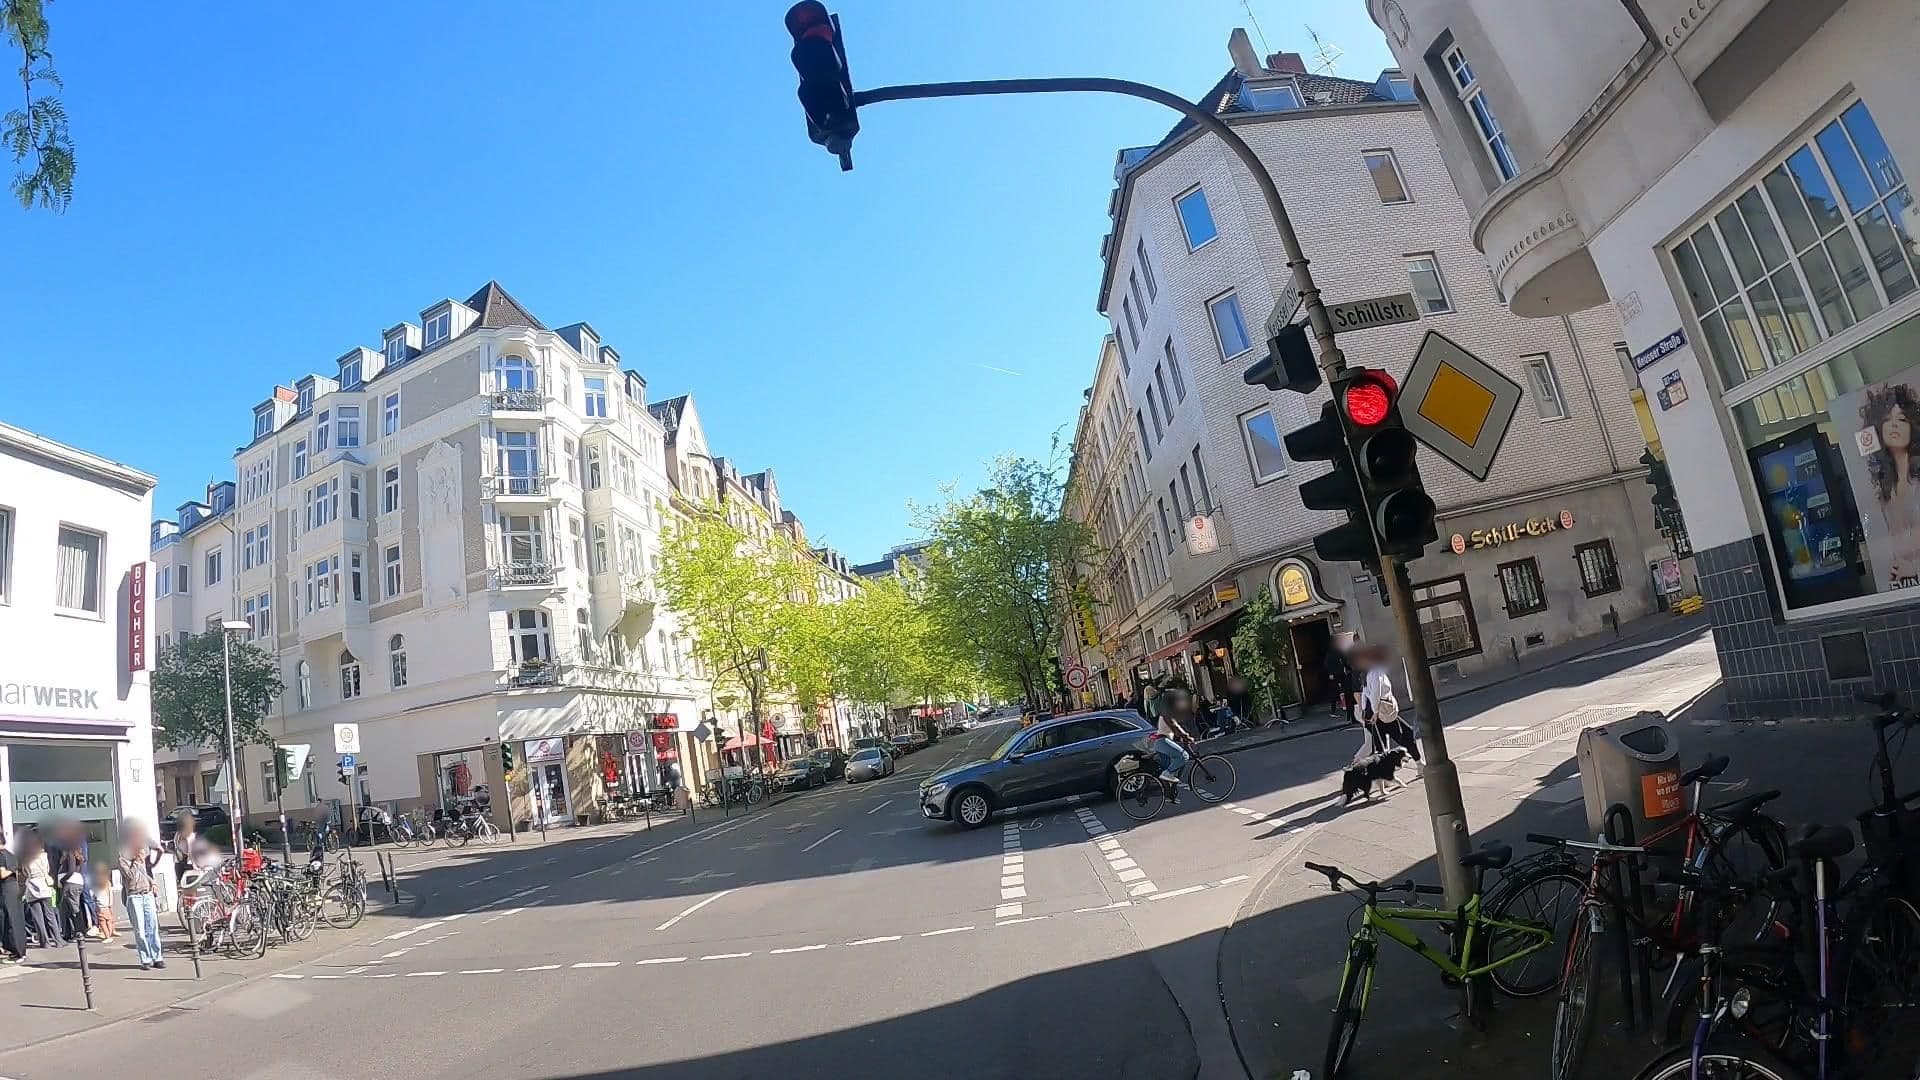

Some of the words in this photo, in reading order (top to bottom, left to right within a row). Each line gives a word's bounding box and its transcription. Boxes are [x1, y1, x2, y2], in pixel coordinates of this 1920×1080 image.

[1334, 301, 1413, 327] Schillstr.
[1637, 347, 1660, 367] Neusser
[1660, 335, 1681, 354] Straße
[1471, 517, 1557, 549] Schill-Eck
[133, 566, 142, 666] BÜCHER
[15, 793, 108, 811] HaarWERK
